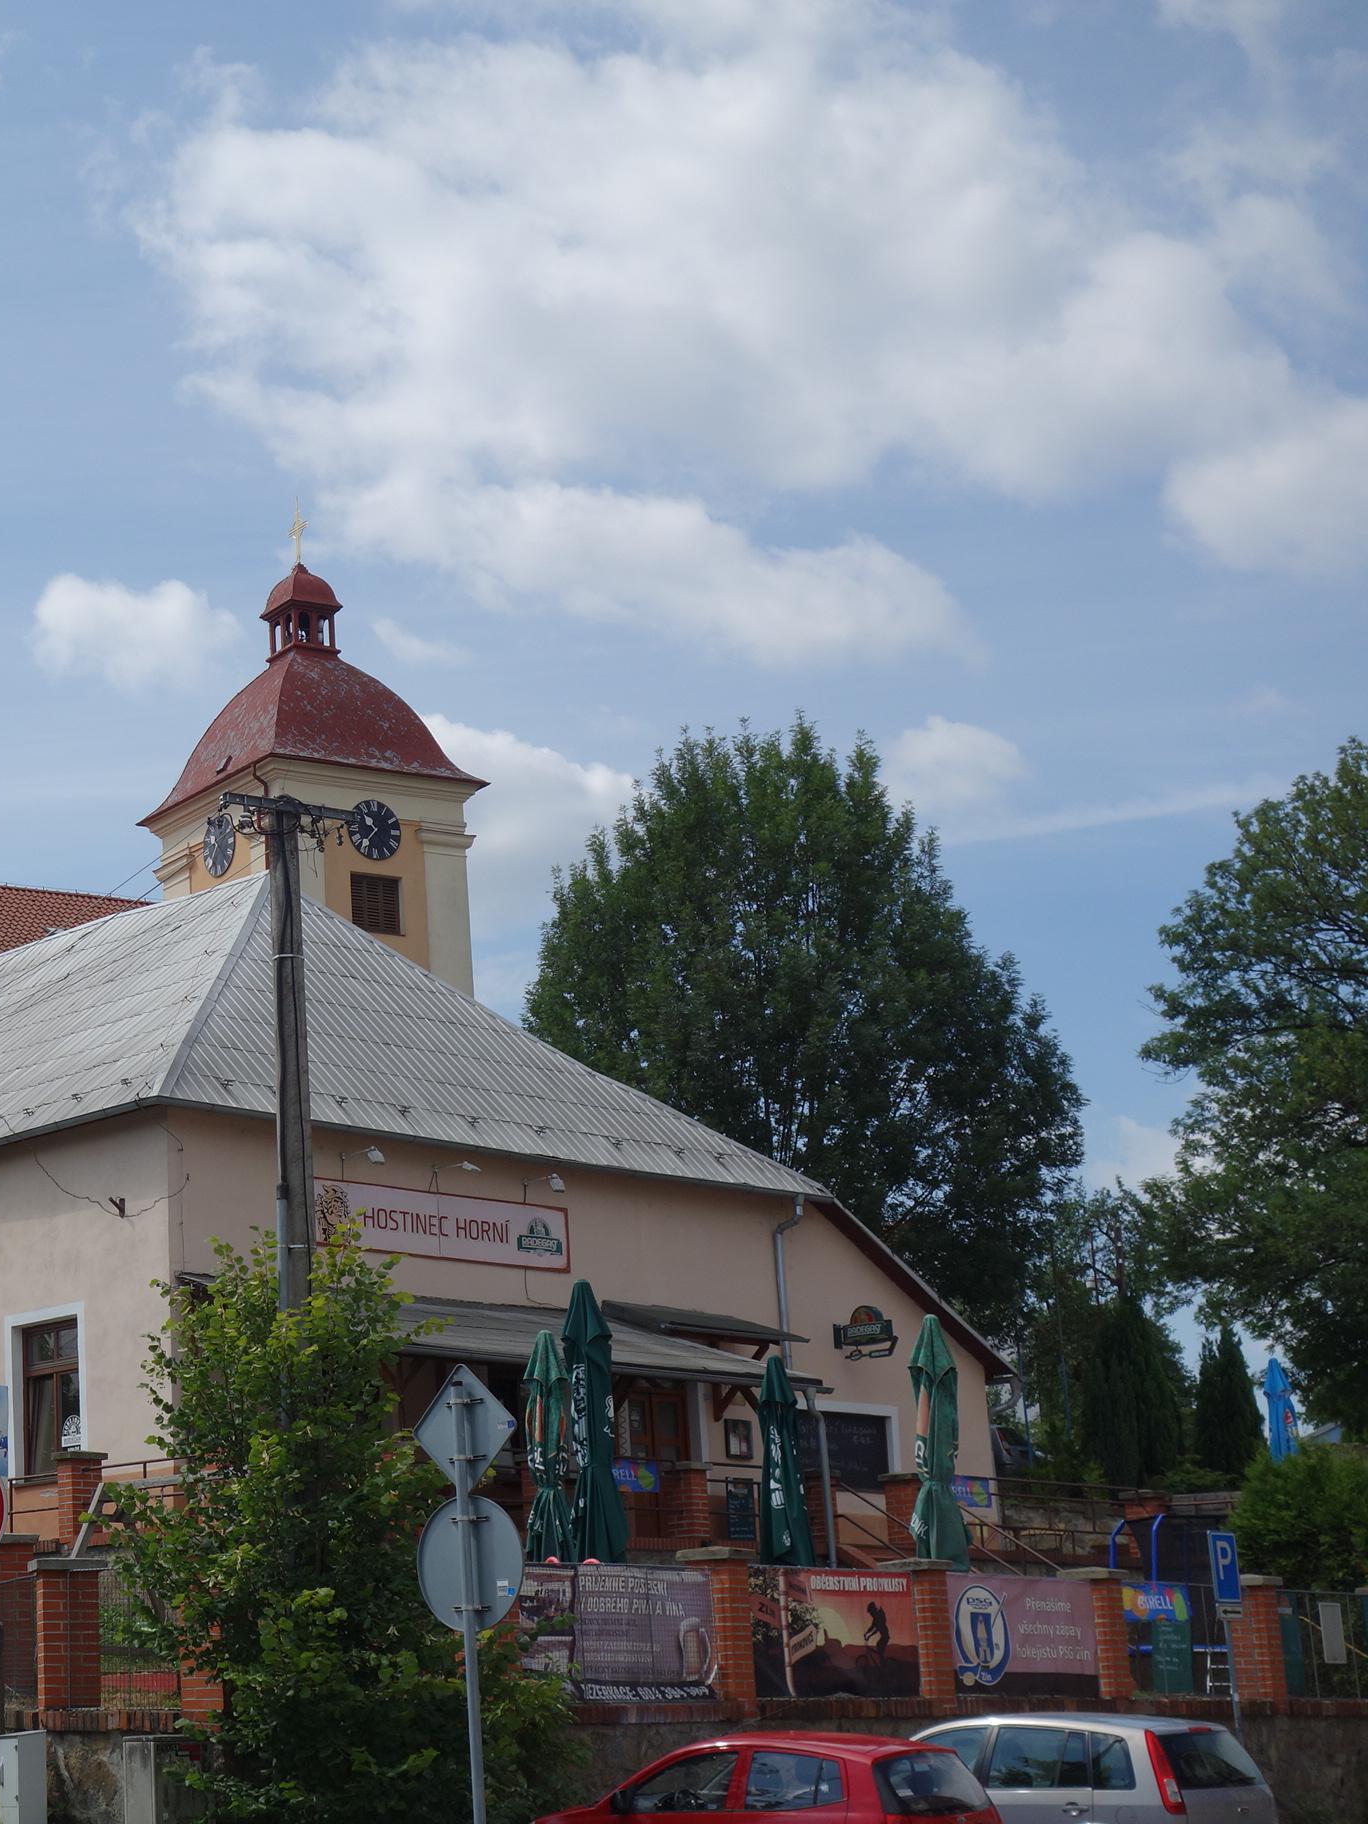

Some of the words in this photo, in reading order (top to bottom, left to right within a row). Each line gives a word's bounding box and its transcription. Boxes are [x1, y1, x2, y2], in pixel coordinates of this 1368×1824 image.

[363, 1207, 449, 1237] HOSTINEC
[456, 1217, 511, 1244] HORNÍ
[611, 1469, 647, 1481] RELL
[1215, 1540, 1232, 1580] P
[860, 1577, 878, 1592] PRO
[1138, 1595, 1174, 1610] BIRELL
